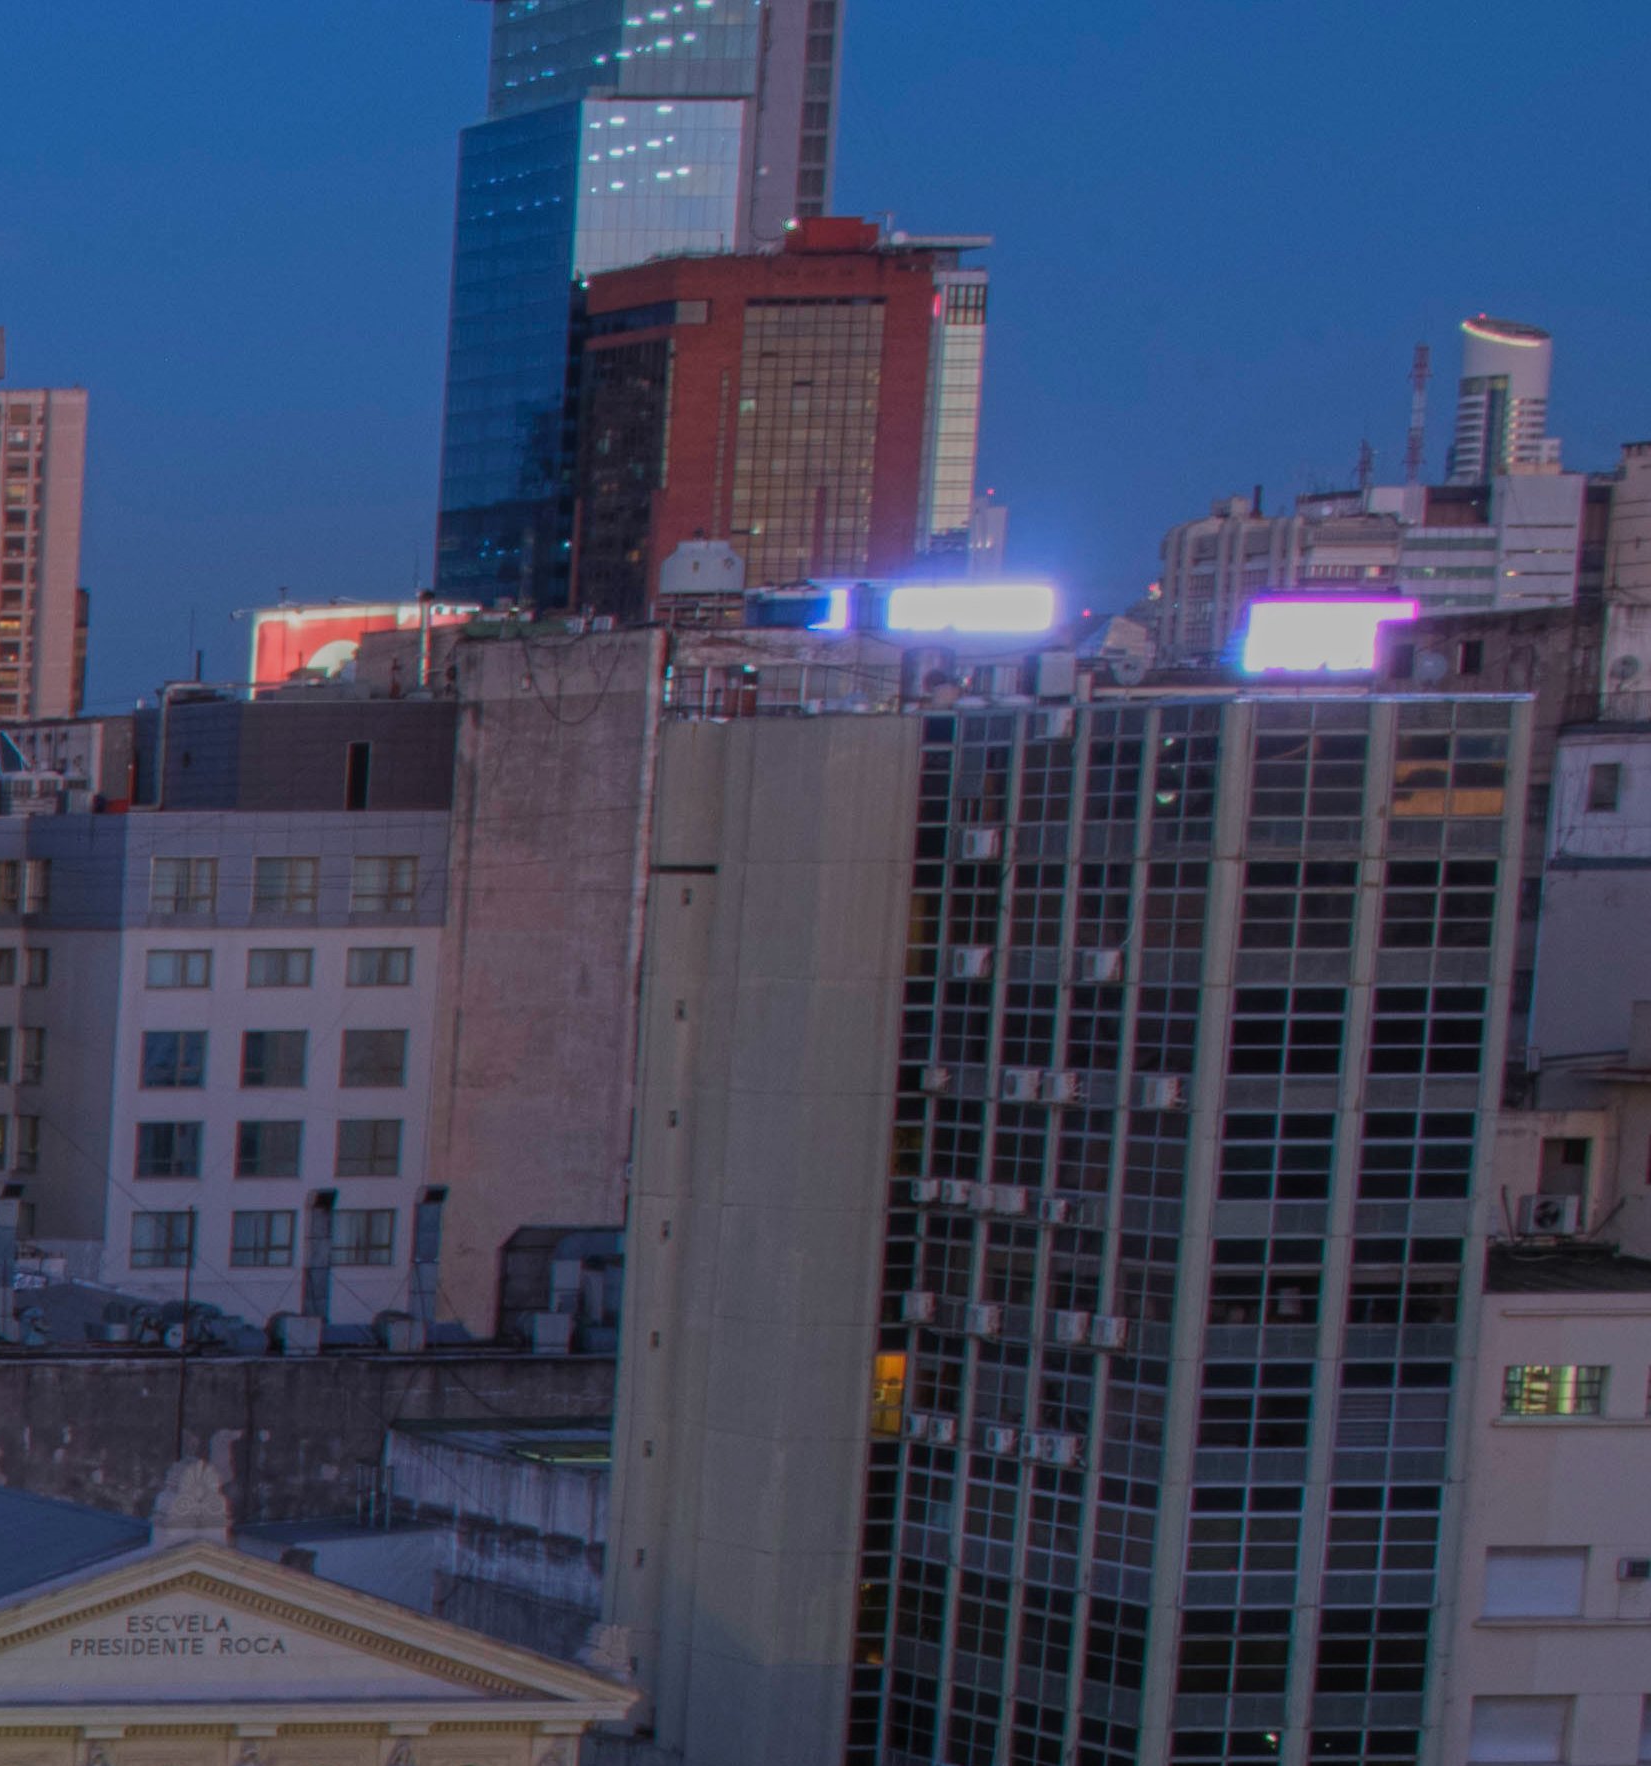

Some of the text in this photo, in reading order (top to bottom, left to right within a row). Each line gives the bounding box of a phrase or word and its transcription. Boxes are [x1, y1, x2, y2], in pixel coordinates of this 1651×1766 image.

[126, 1615, 231, 1634] ESCVELA
[69, 1637, 286, 1656] PRESIDENTE ROCA
